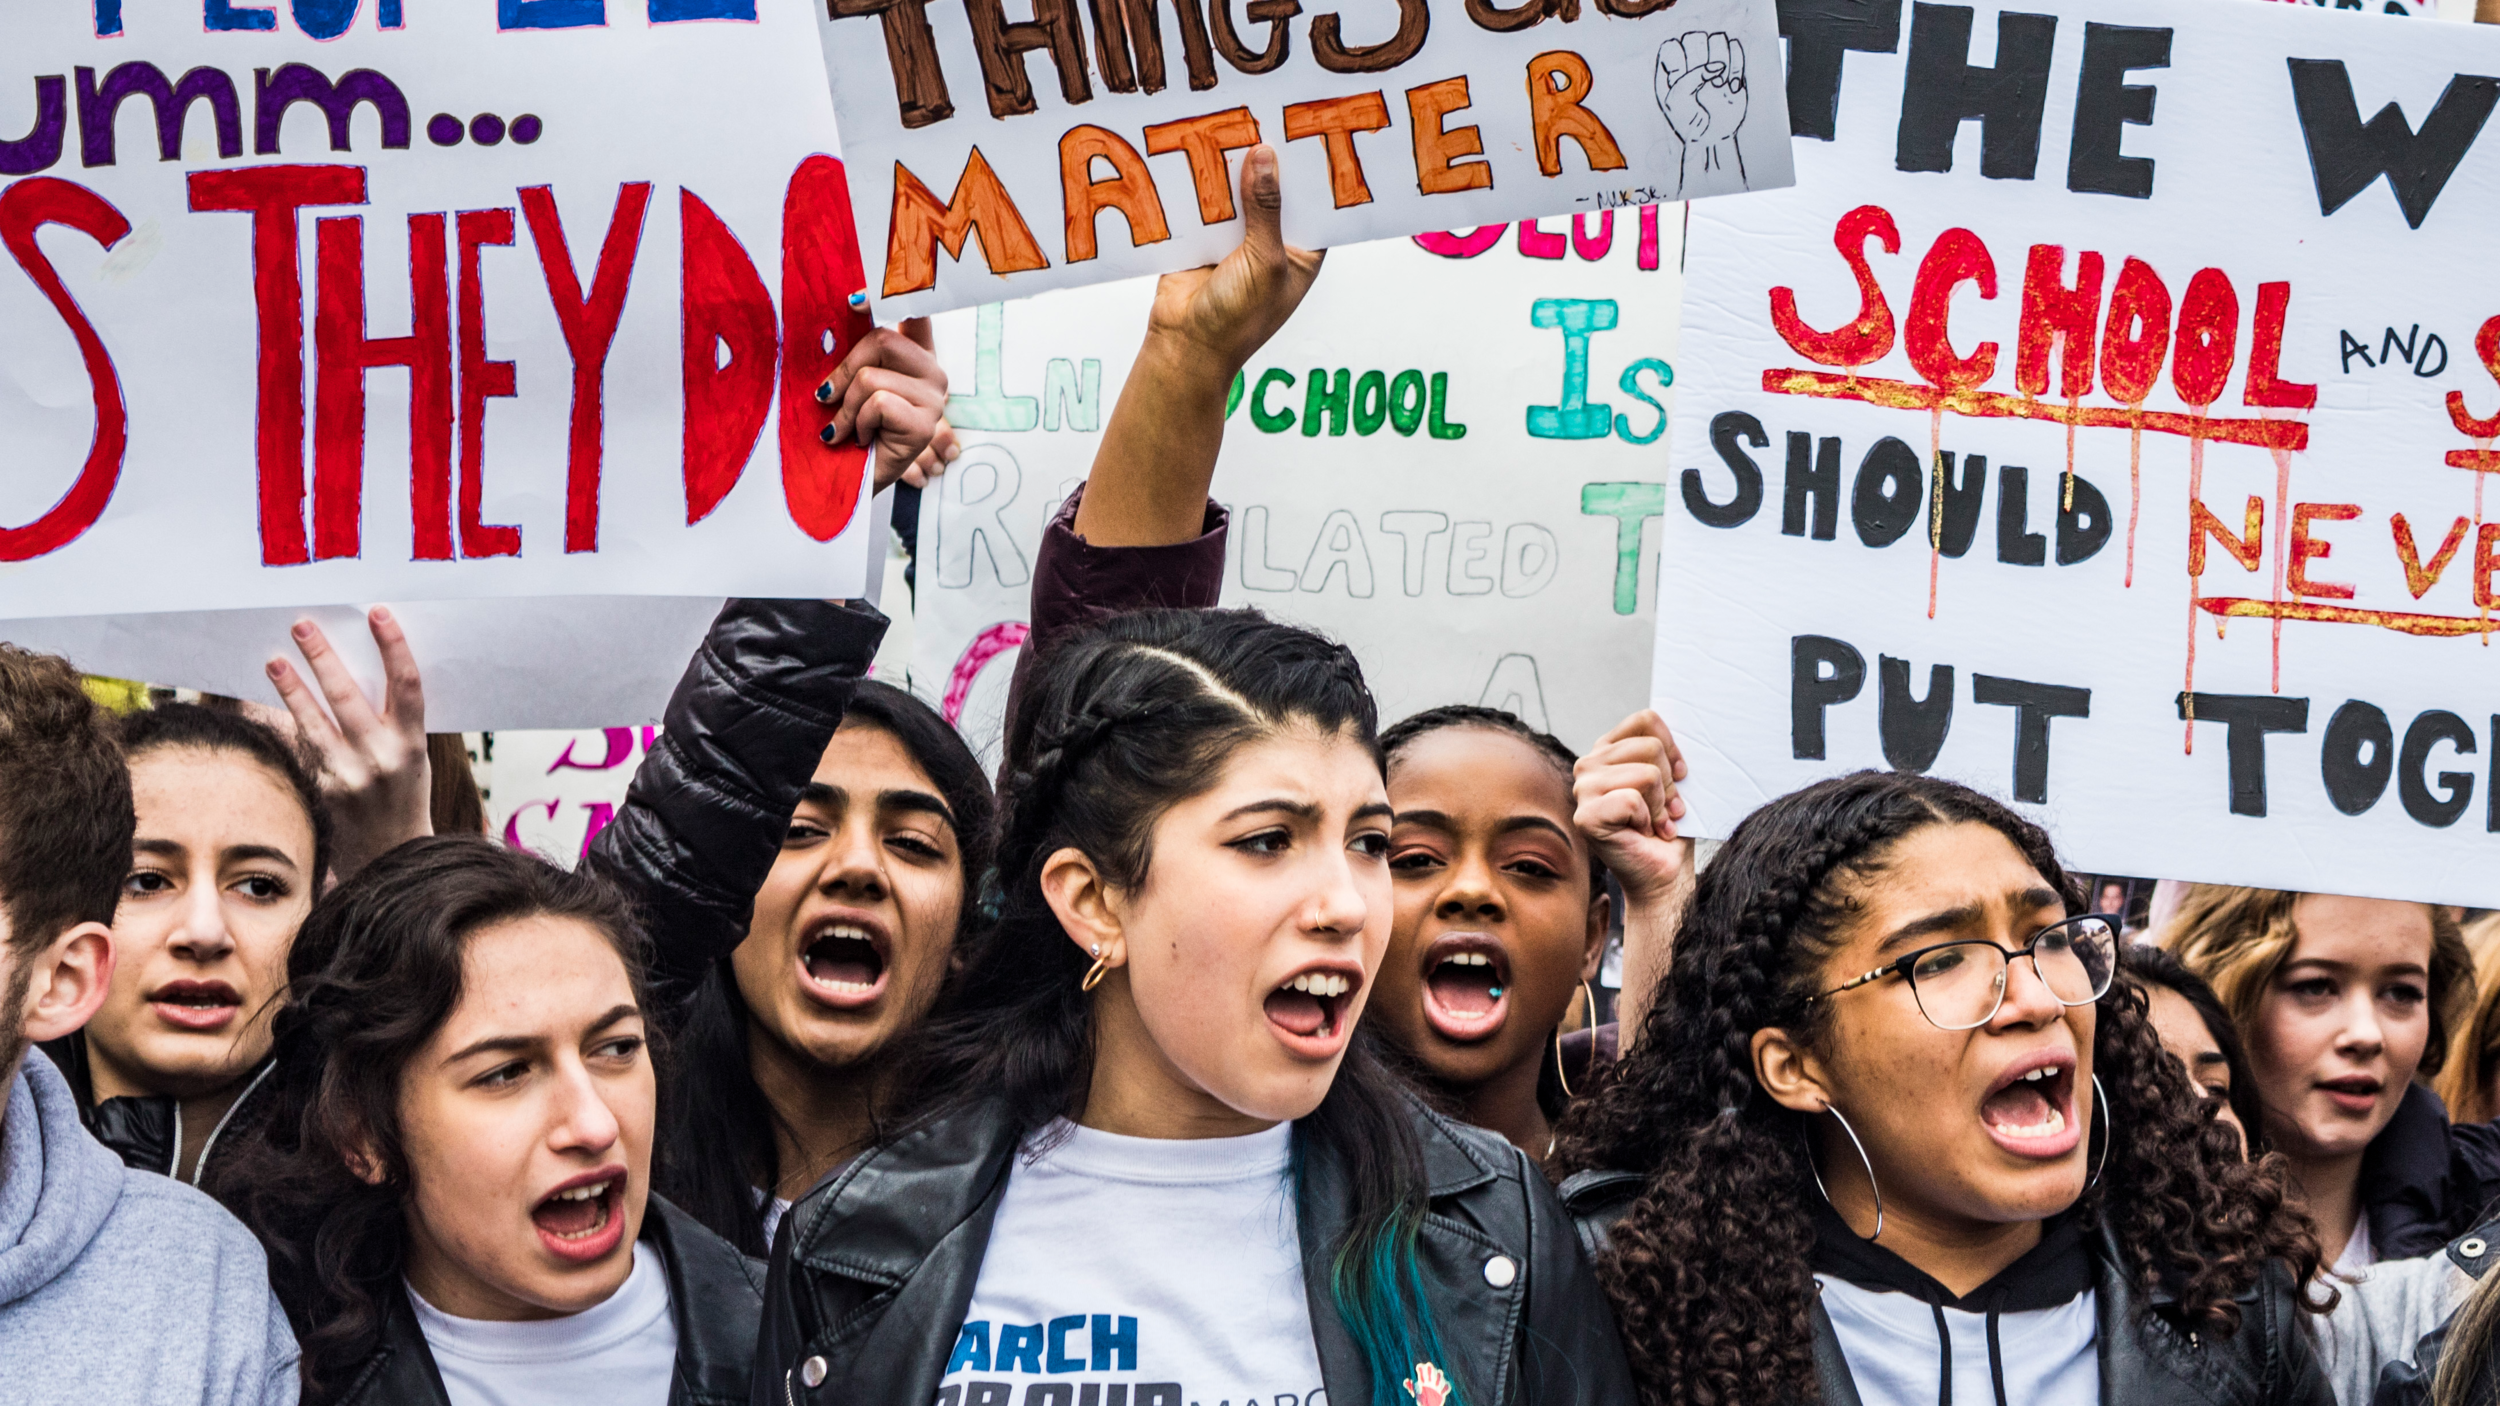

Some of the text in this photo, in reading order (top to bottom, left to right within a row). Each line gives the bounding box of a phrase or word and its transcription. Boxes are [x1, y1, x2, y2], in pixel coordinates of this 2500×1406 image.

[881, 49, 1628, 299] MATTER
[1777, 0, 2174, 199] THE
[187, 163, 655, 567] THEY
[679, 151, 873, 544] DO
[1224, 365, 1467, 440] CHOOL
[1769, 204, 2318, 411] SCHOOL
[2340, 322, 2448, 378] AND
[1681, 410, 2113, 566] SHOULD
[1790, 634, 2500, 834] PUT TOG
